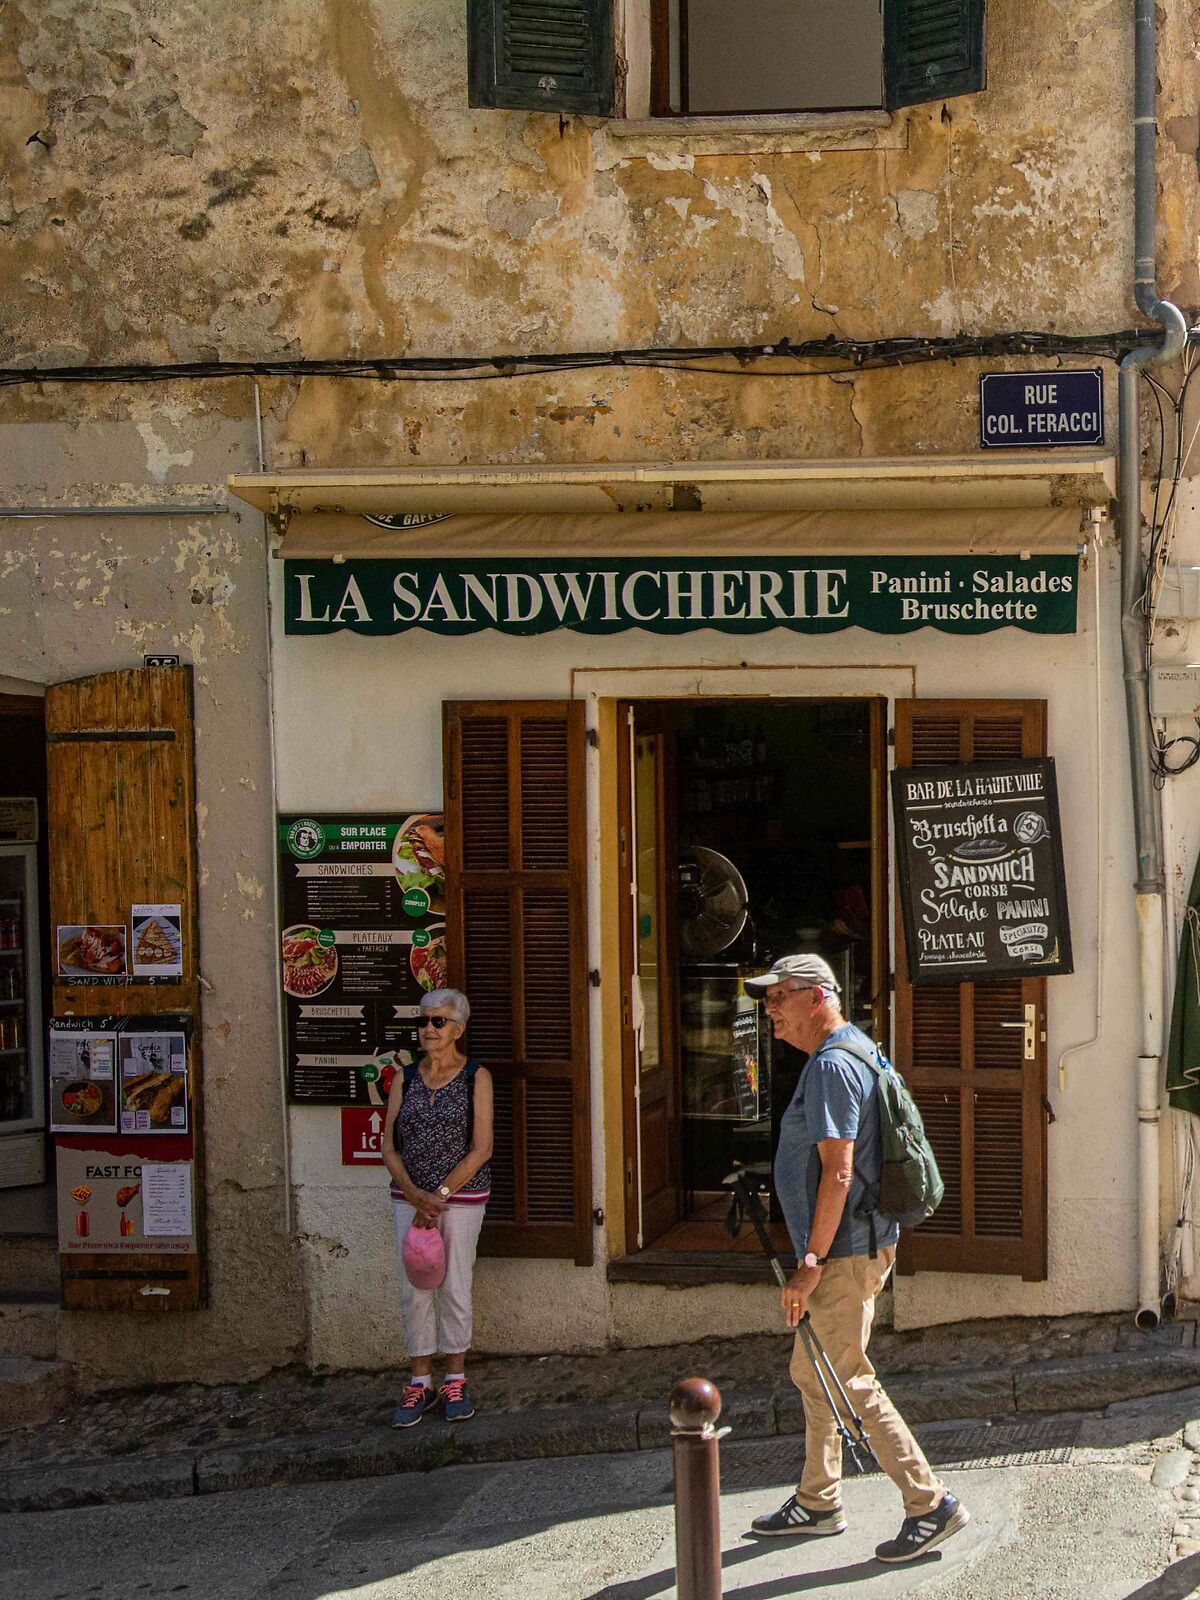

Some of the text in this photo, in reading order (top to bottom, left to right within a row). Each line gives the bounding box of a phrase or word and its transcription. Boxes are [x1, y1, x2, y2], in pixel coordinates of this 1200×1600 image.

[1024, 384, 1058, 404] RUE
[986, 412, 1097, 434] COL. FERACCI
[870, 570, 1072, 594] Panini Salades
[294, 569, 850, 622] LA SANDWICHERIE
[901, 598, 1038, 620] Bruschette
[906, 773, 1043, 800] BAR DE LA HAUTE VILLE
[340, 828, 386, 836] SUR PLACE
[910, 814, 1008, 843] Bruschetta
[341, 841, 386, 850] EMPORTER
[318, 865, 373, 875] SANDWICHES
[934, 852, 1035, 889] SANDWICH
[964, 884, 1008, 898] CORSE
[921, 888, 1049, 924] Salade PANINI
[352, 933, 392, 942] PLATEAUX
[918, 928, 985, 950] PLATEAU
[49, 1018, 93, 1029] Sandwich
[86, 1166, 120, 1177] FAST
